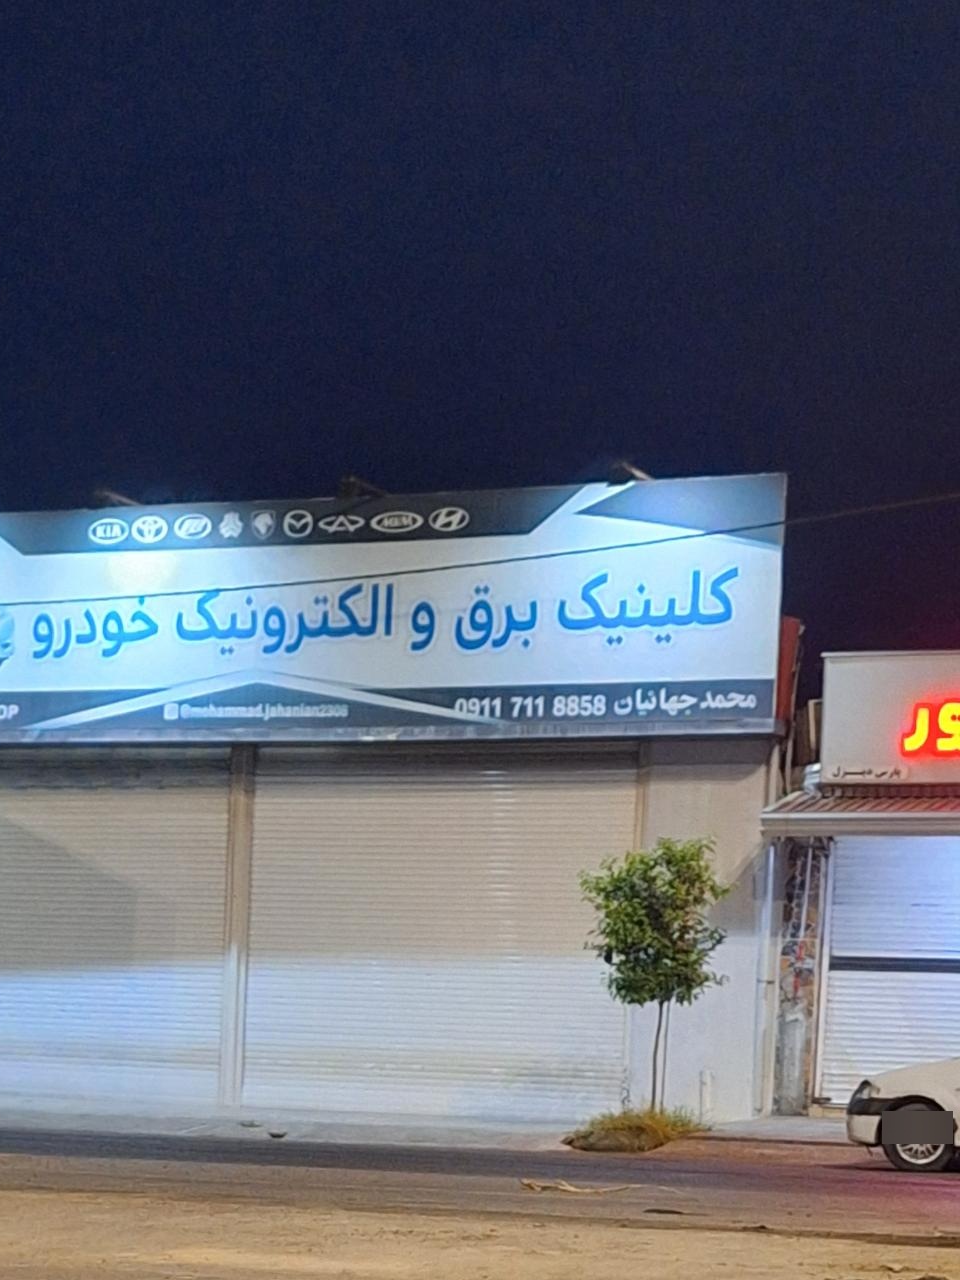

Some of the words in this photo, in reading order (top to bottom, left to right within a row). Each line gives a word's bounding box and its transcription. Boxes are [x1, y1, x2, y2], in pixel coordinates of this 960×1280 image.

[32, 596, 159, 659] خودرو
[175, 582, 394, 656] الکترونیک
[410, 601, 437, 652] و
[455, 584, 538, 651] برق
[557, 566, 740, 646] کلینیک
[454, 696, 502, 719] 0911
[510, 695, 545, 718] 711
[552, 694, 606, 717] 8858
[613, 687, 699, 716] جهانیان
[699, 690, 757, 709] محمد
